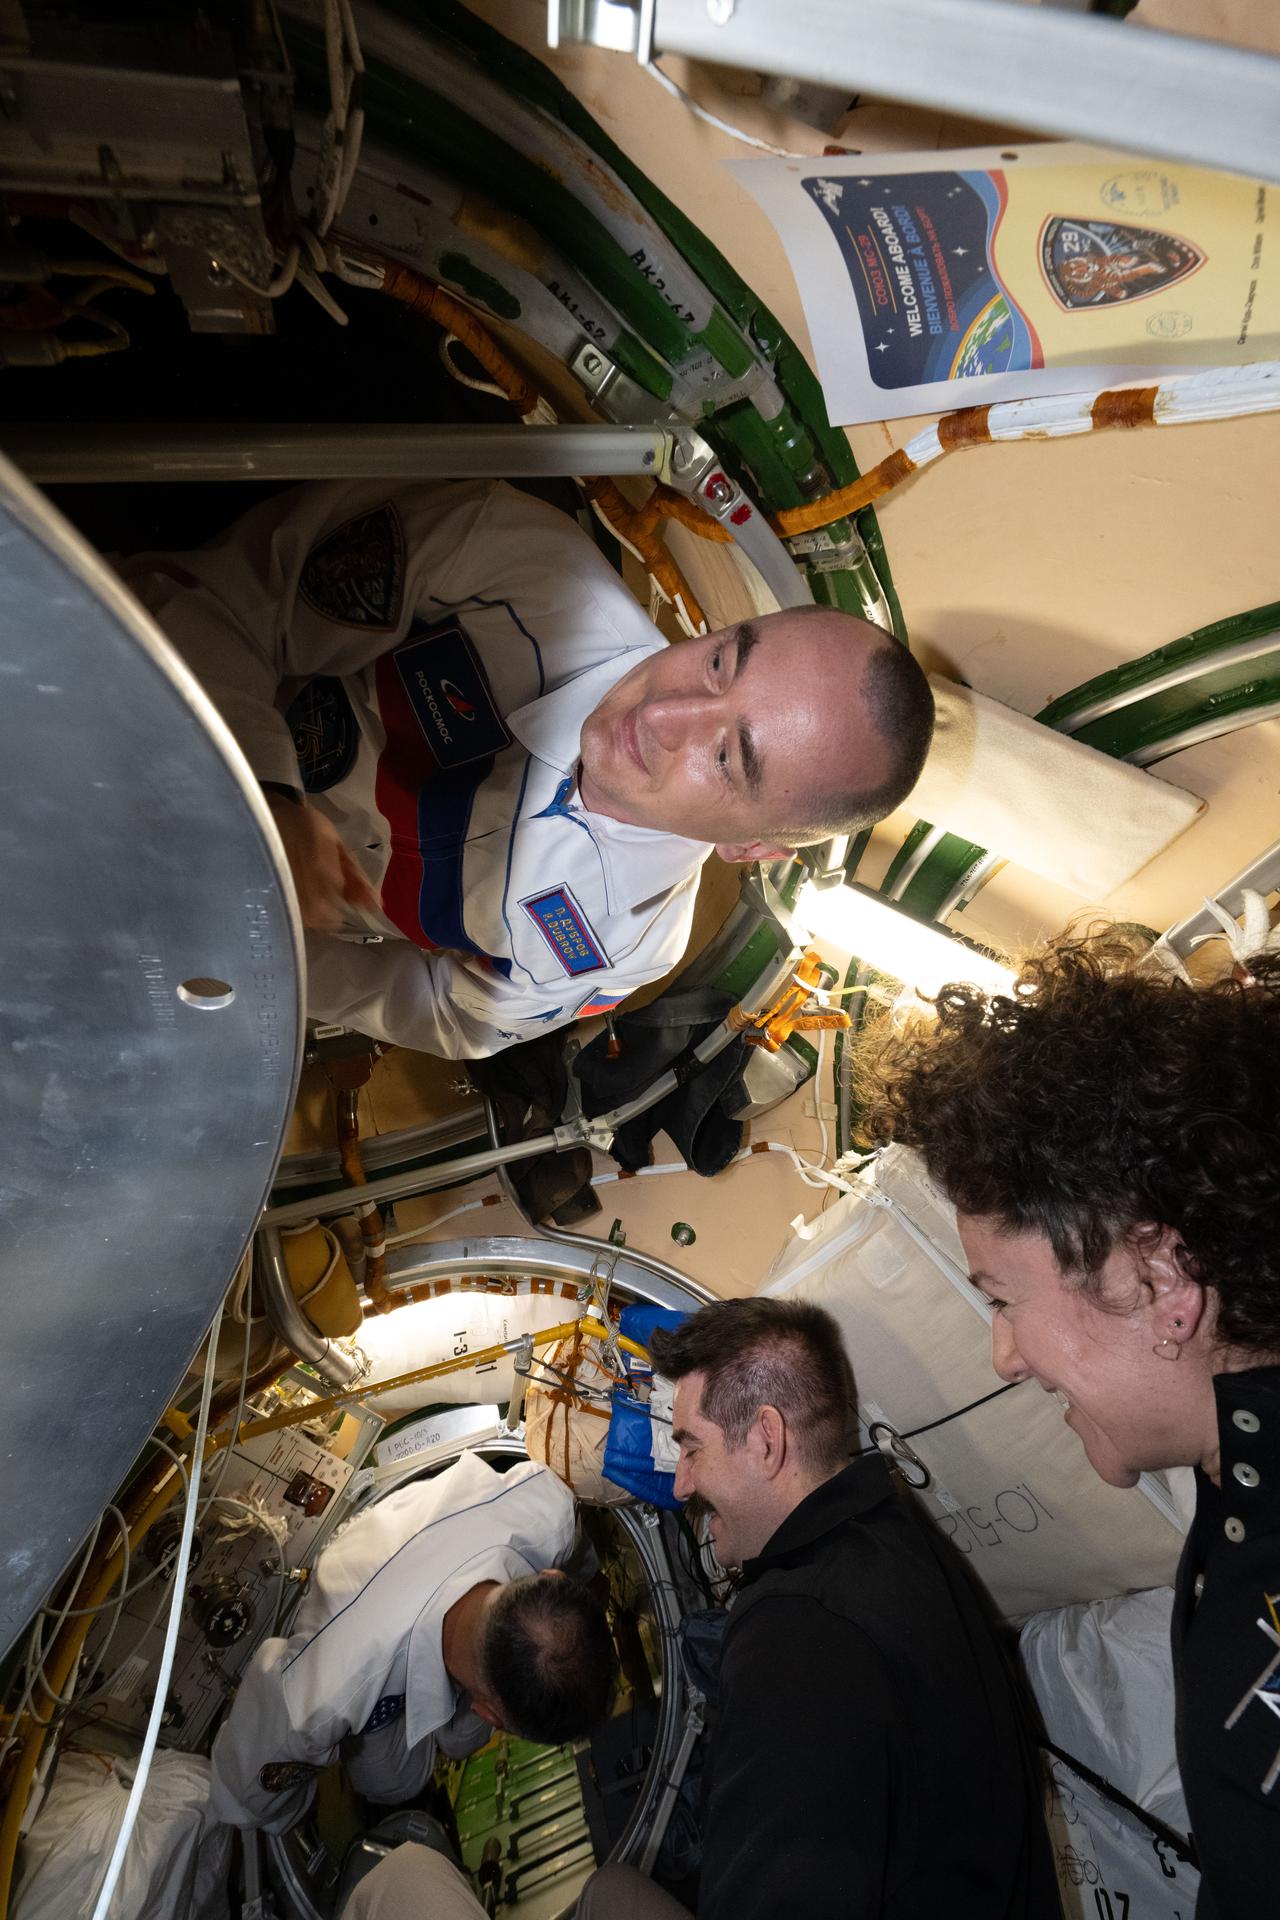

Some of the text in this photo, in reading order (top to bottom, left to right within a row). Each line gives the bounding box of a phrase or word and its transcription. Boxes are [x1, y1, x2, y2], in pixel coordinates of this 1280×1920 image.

[891, 205, 943, 336] BIENVENUE À BORD!
[1061, 231, 1081, 253] 29
[870, 207, 923, 337] WELCOME ABOARD!
[415, 670, 453, 745] РОСКОСМОС
[547, 919, 578, 962] DUBROV
[560, 915, 590, 959] ДУБРОВ
